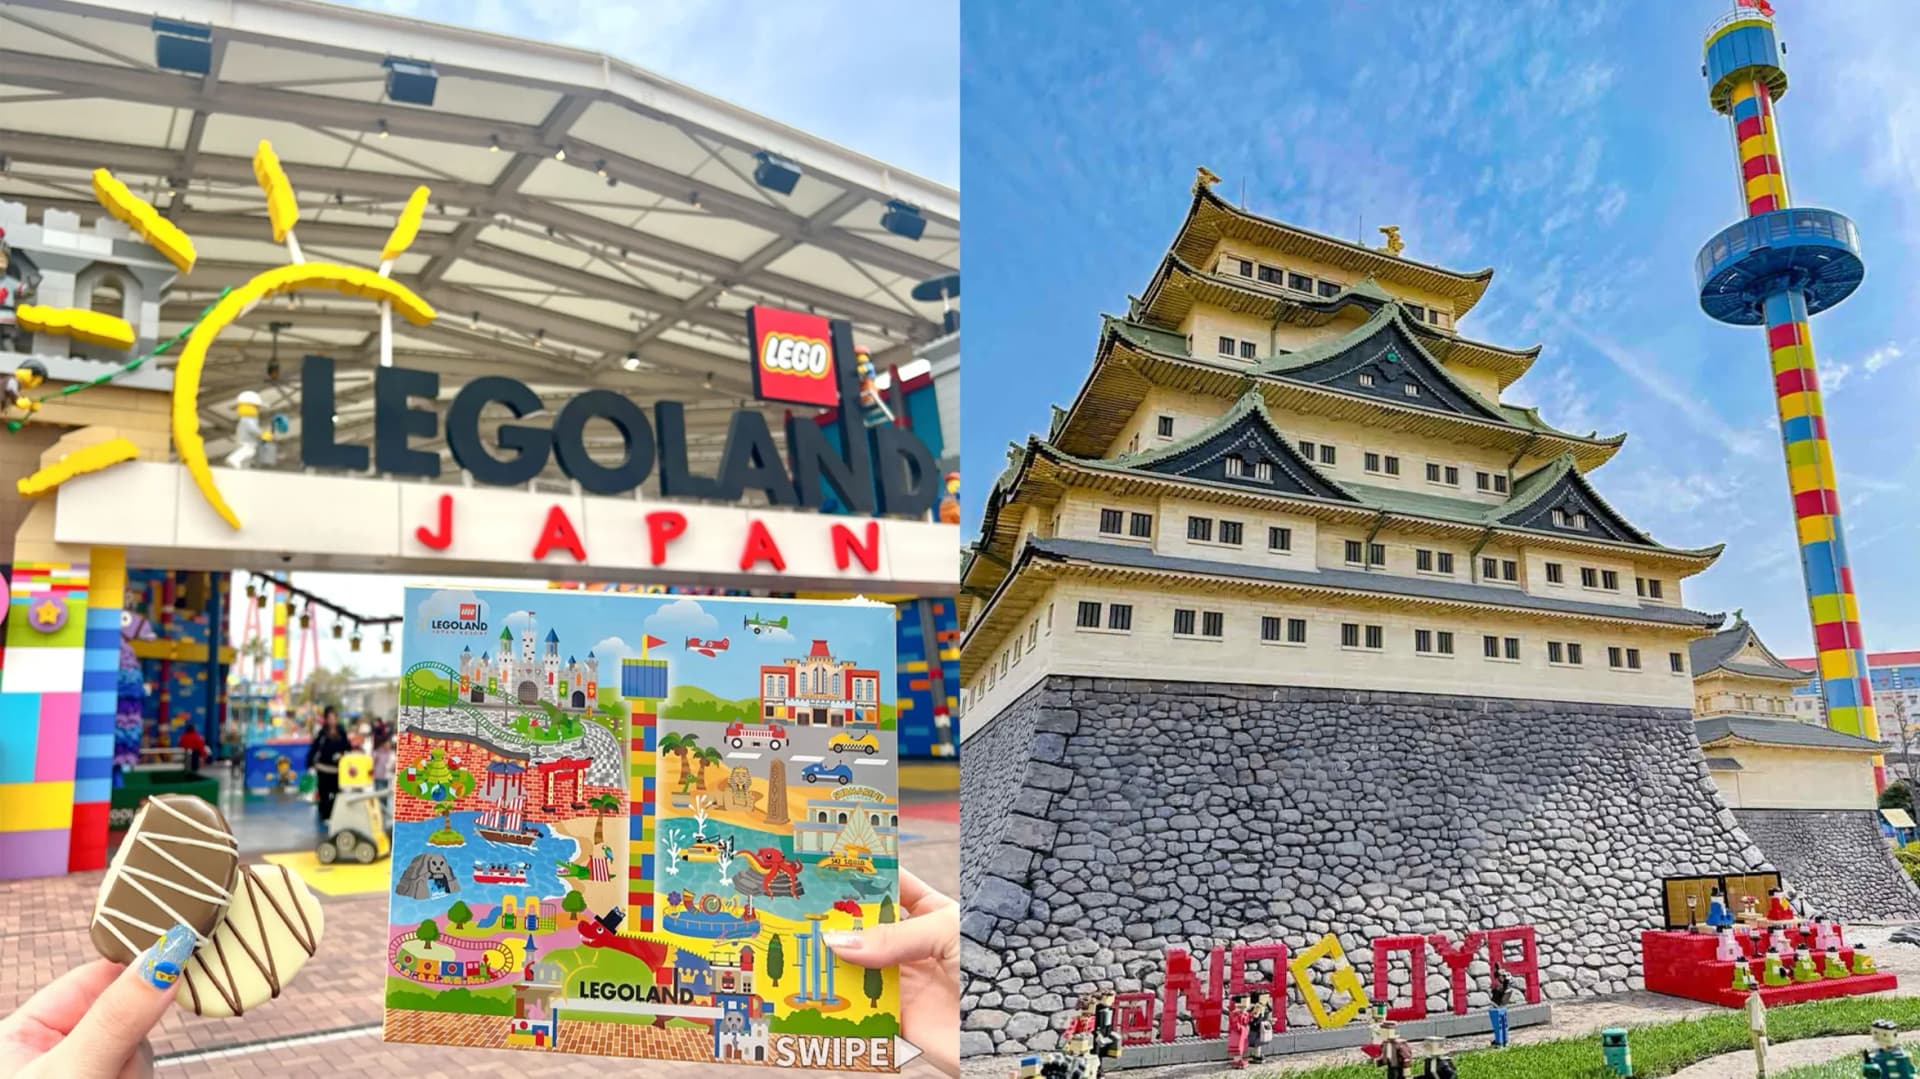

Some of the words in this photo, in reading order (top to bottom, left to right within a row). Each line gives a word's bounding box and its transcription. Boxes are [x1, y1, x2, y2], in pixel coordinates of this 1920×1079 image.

[765, 336, 827, 374] LEGO
[302, 320, 940, 515] LEGOLAND
[415, 494, 881, 572] JAPAN
[580, 967, 693, 1004] LEGOLAND
